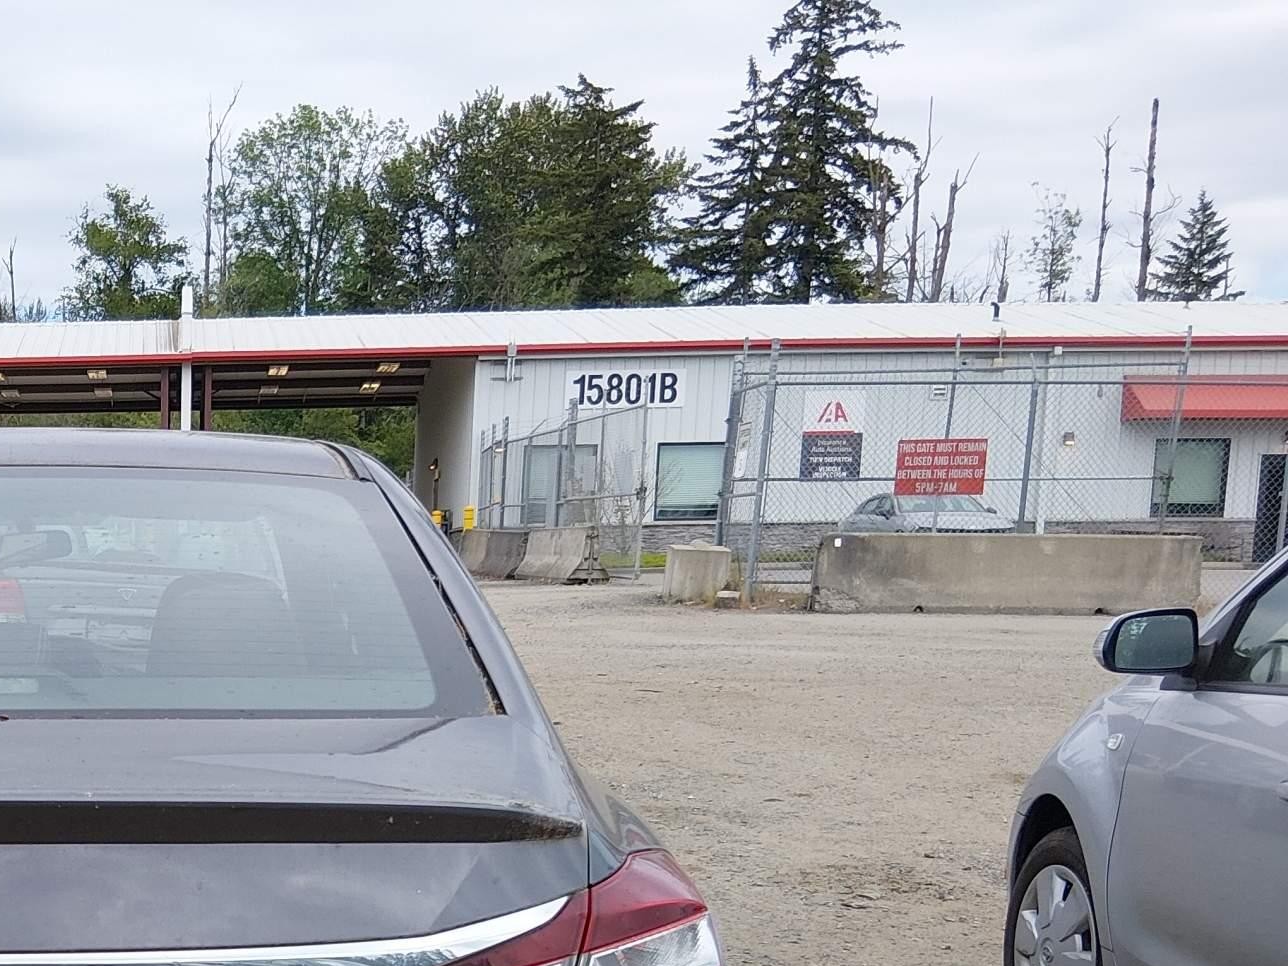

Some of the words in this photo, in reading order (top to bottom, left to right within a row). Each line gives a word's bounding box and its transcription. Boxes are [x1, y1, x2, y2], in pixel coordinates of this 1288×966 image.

[572, 373, 678, 406] 15801B
[899, 443, 916, 453] THIS
[917, 443, 935, 453] GATE
[936, 442, 957, 452] MUST
[958, 442, 987, 452] REMAIN
[904, 456, 933, 466] CLOSED
[933, 456, 949, 466] AND
[950, 455, 979, 465] LOCKED
[897, 469, 931, 479] BETWEEN
[932, 469, 948, 479] THE
[948, 468, 973, 479] HOURS
[974, 468, 985, 478] OF
